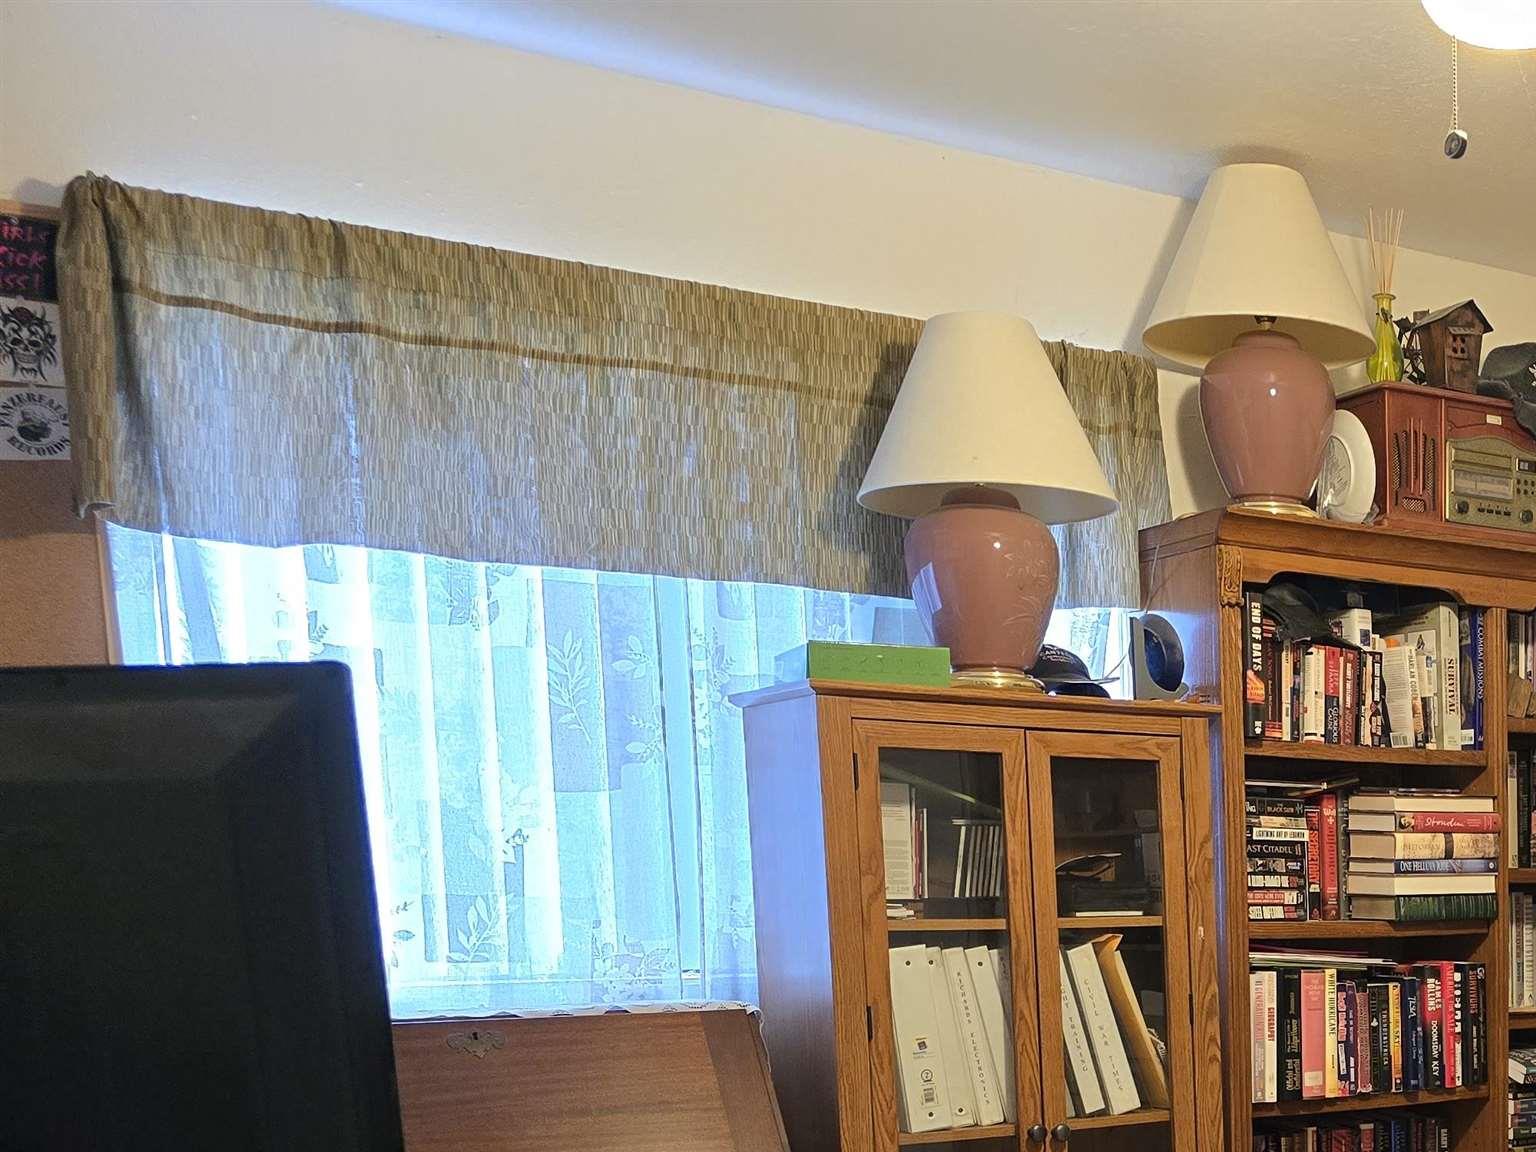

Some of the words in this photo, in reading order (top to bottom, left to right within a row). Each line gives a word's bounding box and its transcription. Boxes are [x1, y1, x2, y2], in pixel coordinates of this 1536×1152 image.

[1251, 602, 1261, 624] END
[1252, 626, 1261, 641] OF
[1253, 643, 1263, 671] DAYS
[1447, 658, 1456, 715] SURVIVAL
[1247, 843, 1262, 852] AST
[1263, 843, 1293, 854] CITADEL
[1328, 973, 1336, 995] WHITE
[1426, 978, 1436, 1012] ROLLINS
[1469, 970, 1478, 1014] SURVIVORS
[1267, 1007, 1275, 1042] GEOGRAPHY
[1328, 997, 1336, 1036] HURRICANE
[1408, 996, 1416, 1019] TESLA
[956, 971, 973, 1025] RICHARDS
[970, 1031, 990, 1105] ELECTRONICS
[1068, 1016, 1089, 1073] TRAINING
[1083, 978, 1100, 1017] CIVIL
[1098, 1024, 1109, 1047] WAR
[1108, 1055, 1123, 1092] TIMES
[1431, 1060, 1439, 1076] KEY
